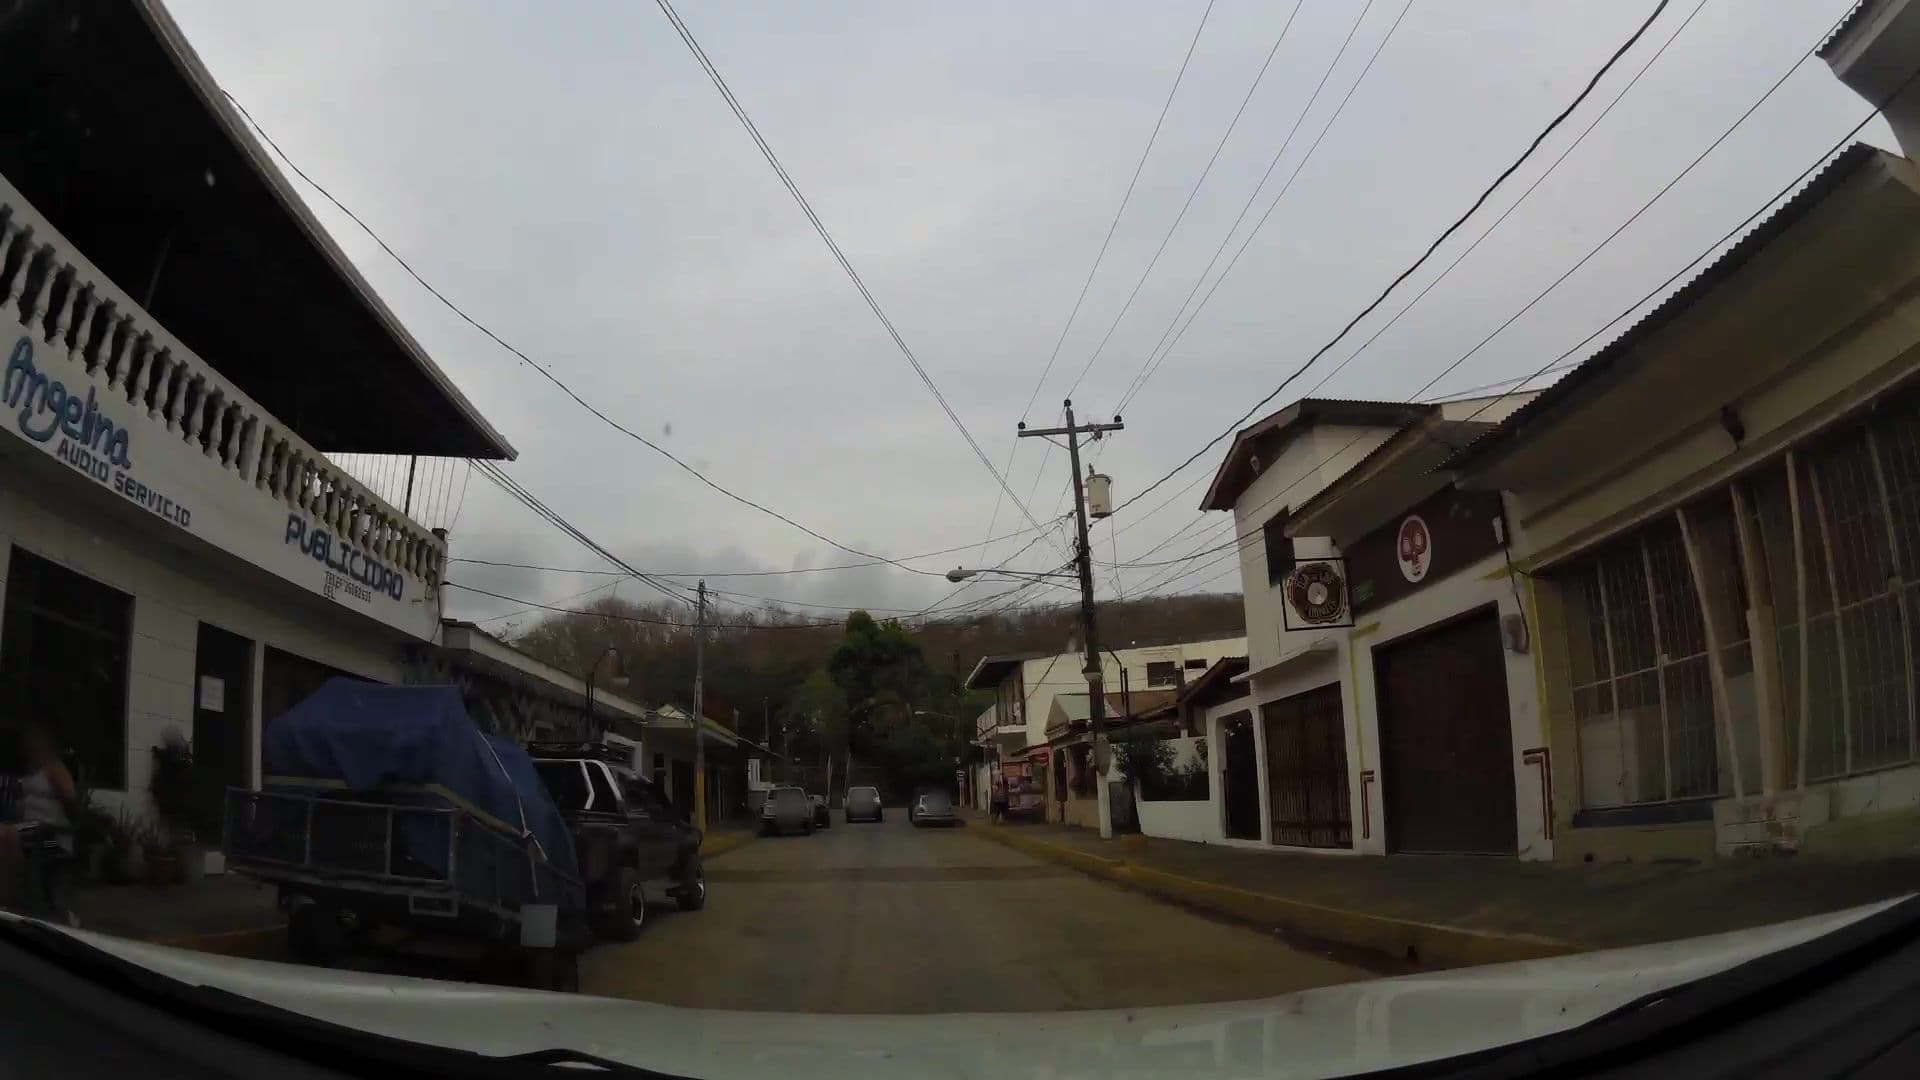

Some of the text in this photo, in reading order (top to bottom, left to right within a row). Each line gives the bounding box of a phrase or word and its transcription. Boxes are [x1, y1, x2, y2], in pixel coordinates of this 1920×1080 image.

[2, 336, 131, 469] Angelina
[55, 438, 192, 527] AUDIO SERVICIO
[285, 512, 404, 602] PUBLICIDAD
